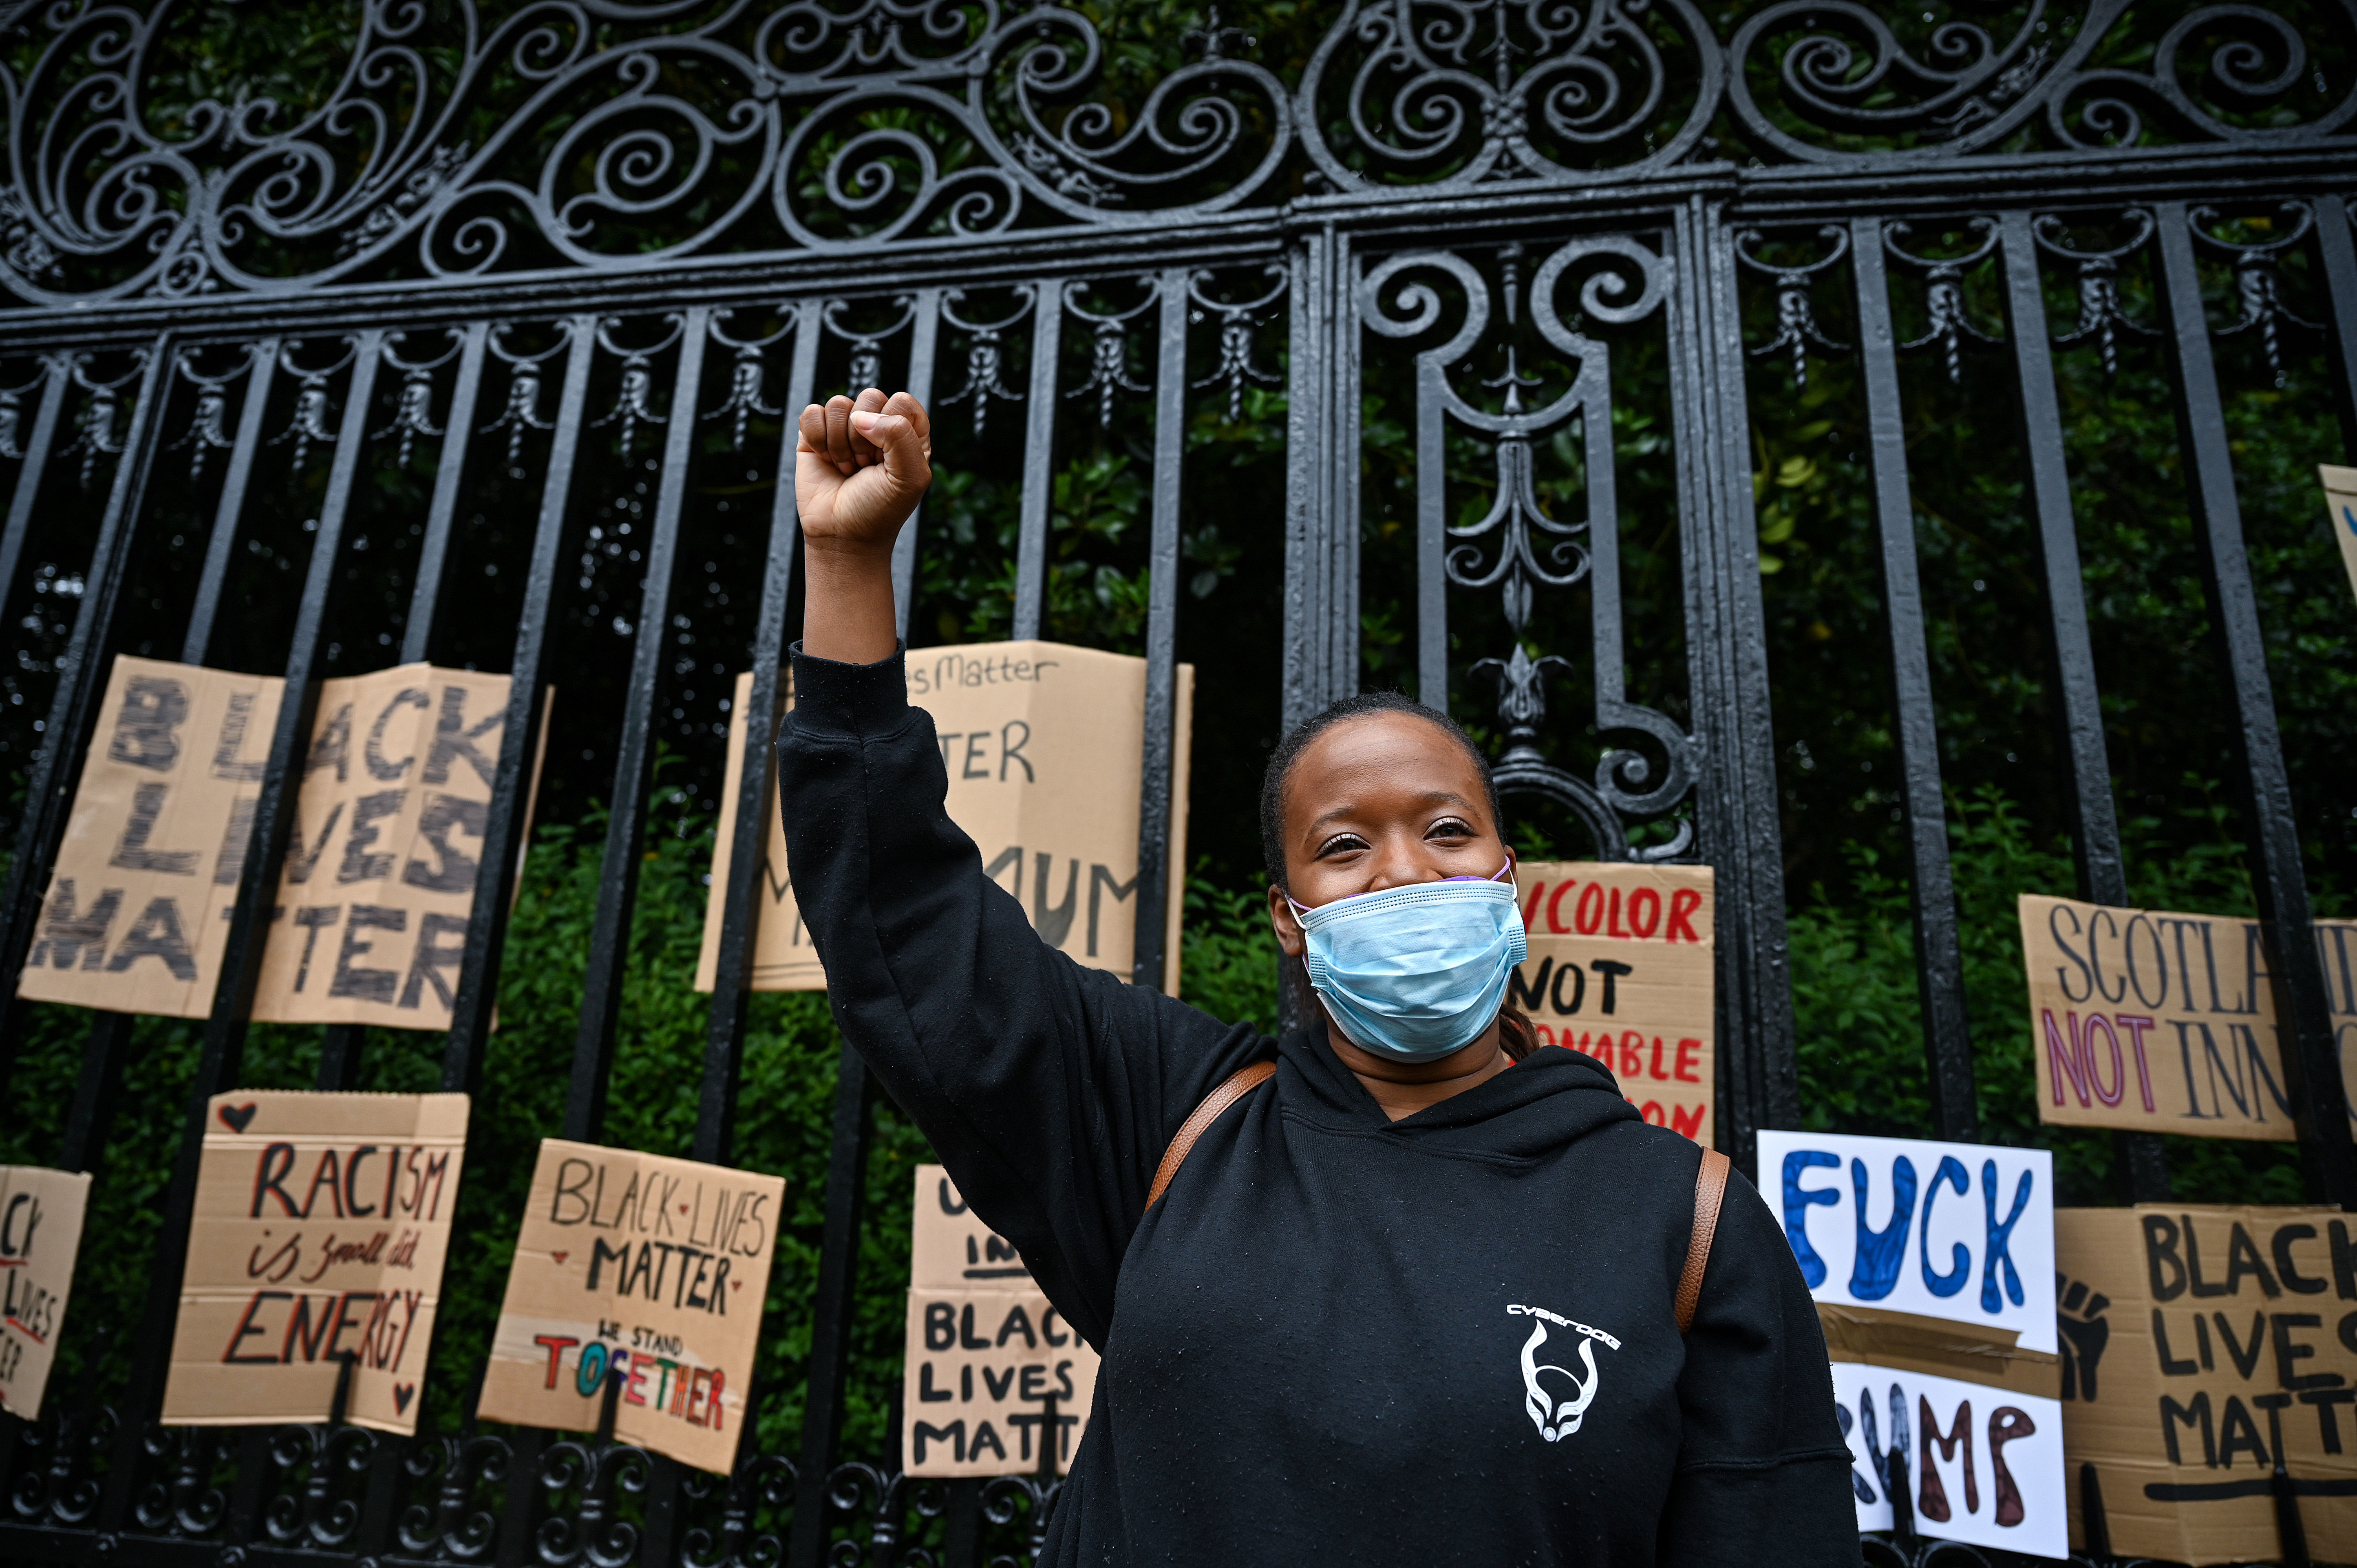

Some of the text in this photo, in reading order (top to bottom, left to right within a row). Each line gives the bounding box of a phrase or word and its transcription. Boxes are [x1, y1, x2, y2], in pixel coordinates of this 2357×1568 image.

[108, 675, 507, 792] BLACK
[108, 782, 492, 893] LIVES
[1546, 878, 1703, 944] COLOR
[2041, 1007, 2157, 1114] NOT
[249, 1141, 449, 1221] RACISM
[550, 1158, 769, 1258] BLACK LIVES
[247, 1228, 302, 1284] is
[1781, 1149, 2033, 1314] FUCK
[585, 1236, 732, 1316] MATTER
[220, 1288, 423, 1374] ENERGY
[598, 1318, 684, 1357] WE STAND
[925, 1302, 1088, 1351] BLAC
[919, 1360, 1074, 1403] LIVES
[913, 1412, 1090, 1466] MATT
[2159, 1389, 2357, 1469] MATT
